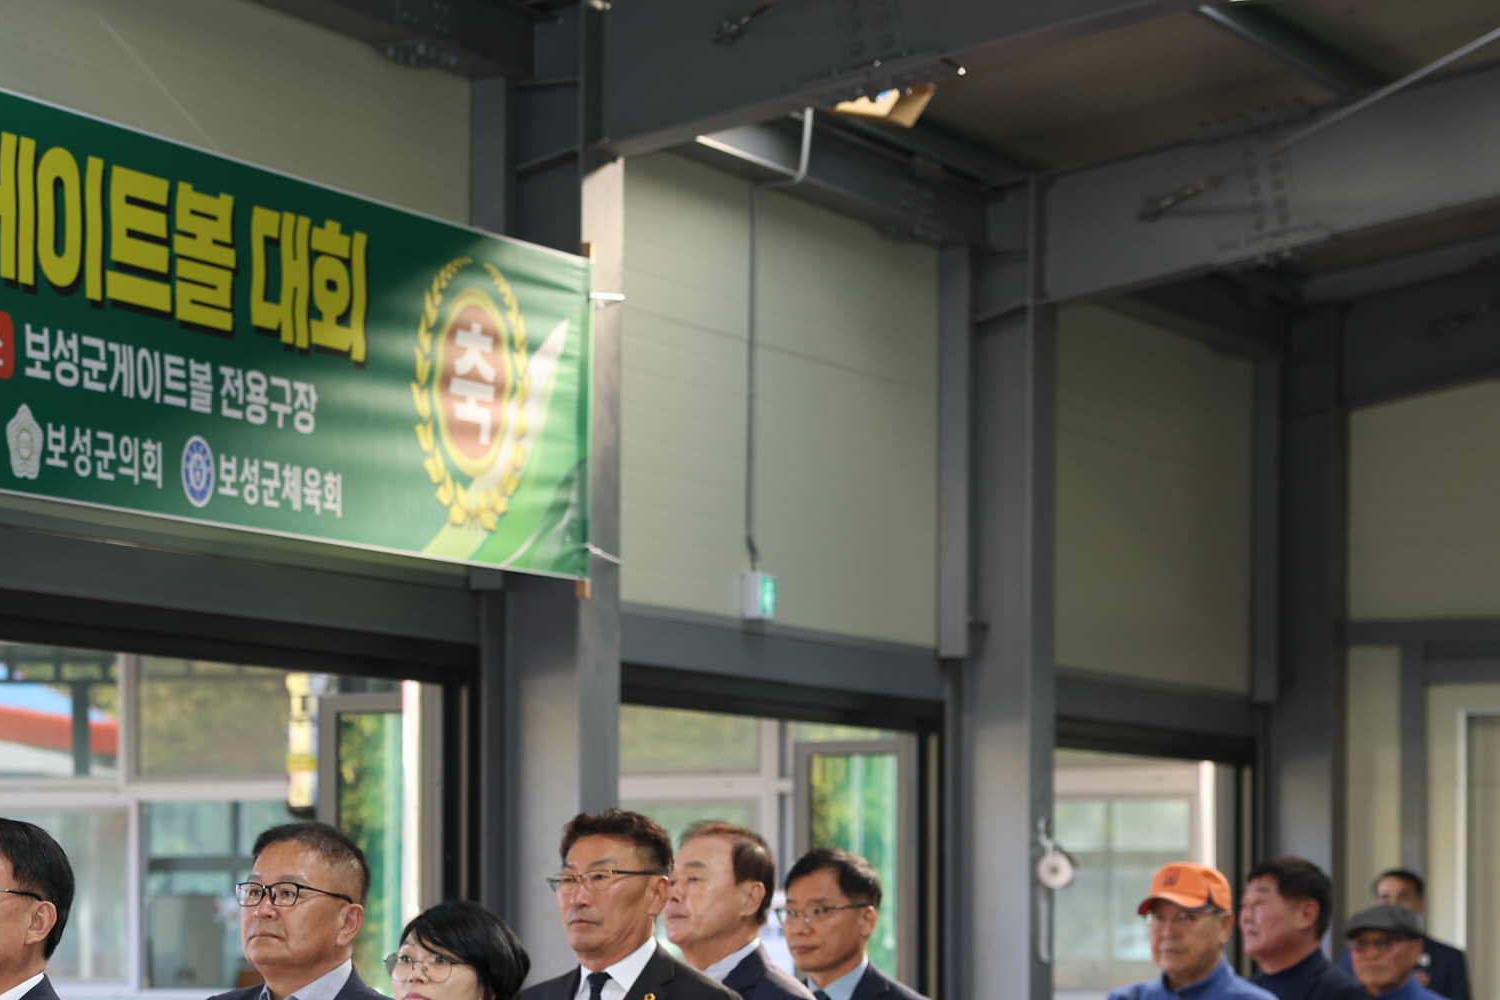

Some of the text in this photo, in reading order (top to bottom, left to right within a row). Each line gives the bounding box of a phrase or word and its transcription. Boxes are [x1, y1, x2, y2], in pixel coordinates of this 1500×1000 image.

[250, 205, 368, 362] 대회
[24, 323, 318, 436] 보성군게이트볼 전용구장
[449, 321, 497, 445] 축
[45, 421, 164, 489] 보성군의회
[218, 453, 343, 519] 보성군체육회
